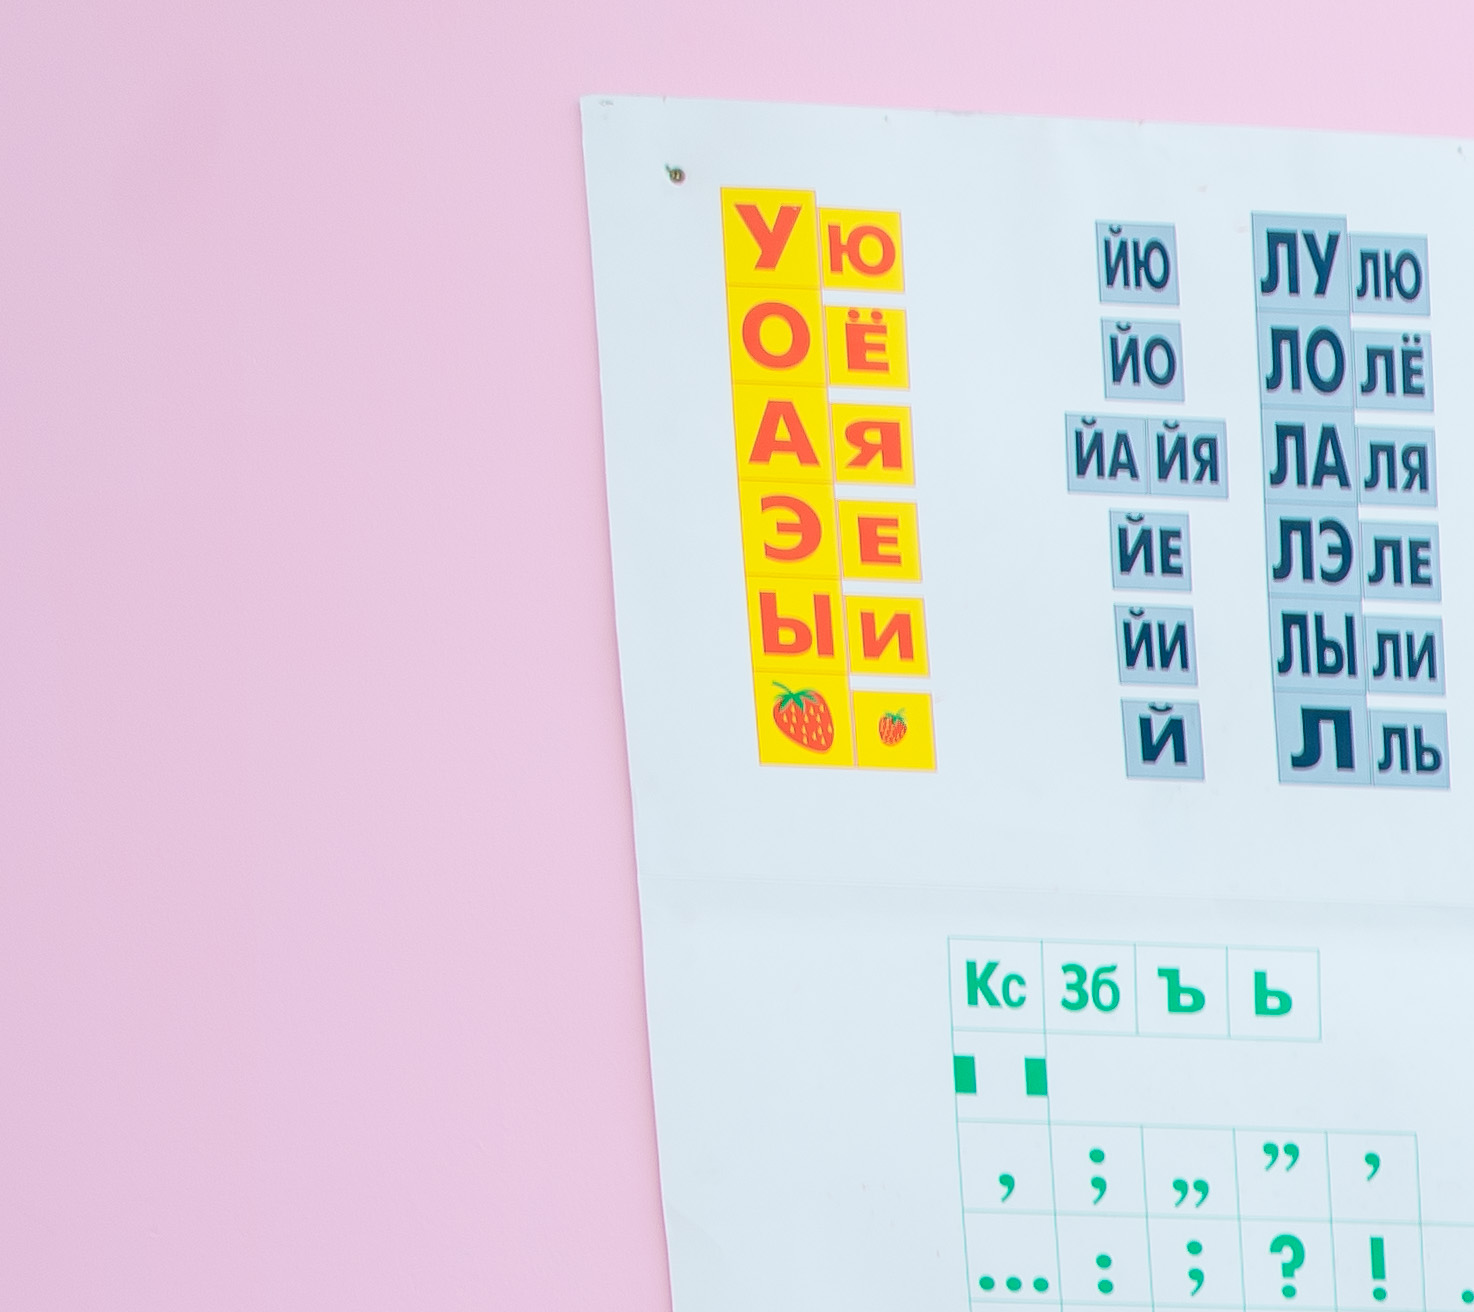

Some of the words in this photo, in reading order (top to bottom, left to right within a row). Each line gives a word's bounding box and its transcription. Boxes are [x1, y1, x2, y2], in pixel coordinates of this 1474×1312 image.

[734, 203, 802, 270] У
[827, 223, 896, 277] Ю
[1260, 228, 1340, 296] ЛУ
[1356, 249, 1422, 301] ЛЮ
[741, 301, 811, 370] О
[844, 308, 890, 372] Ё
[1265, 327, 1345, 394] ЛО
[1360, 333, 1425, 397] ЛЁ
[748, 399, 820, 466] А
[844, 420, 903, 470] Я
[1269, 423, 1351, 489] ЛА
[1363, 441, 1429, 492] ЛЯ
[760, 494, 823, 562] Э
[857, 515, 902, 565] Е
[1272, 517, 1353, 584] ЛЭ
[1367, 537, 1433, 587] ЛЕ
[758, 591, 835, 657] Ы
[860, 611, 914, 661] И
[1277, 612, 1357, 677] ЛЫ
[1372, 631, 1437, 681] ЛИ
[1290, 706, 1355, 770] Л
[1377, 725, 1442, 774] ЛЬ
[1157, 967, 1206, 1014] Ъ
[1253, 970, 1293, 1016] Ь
